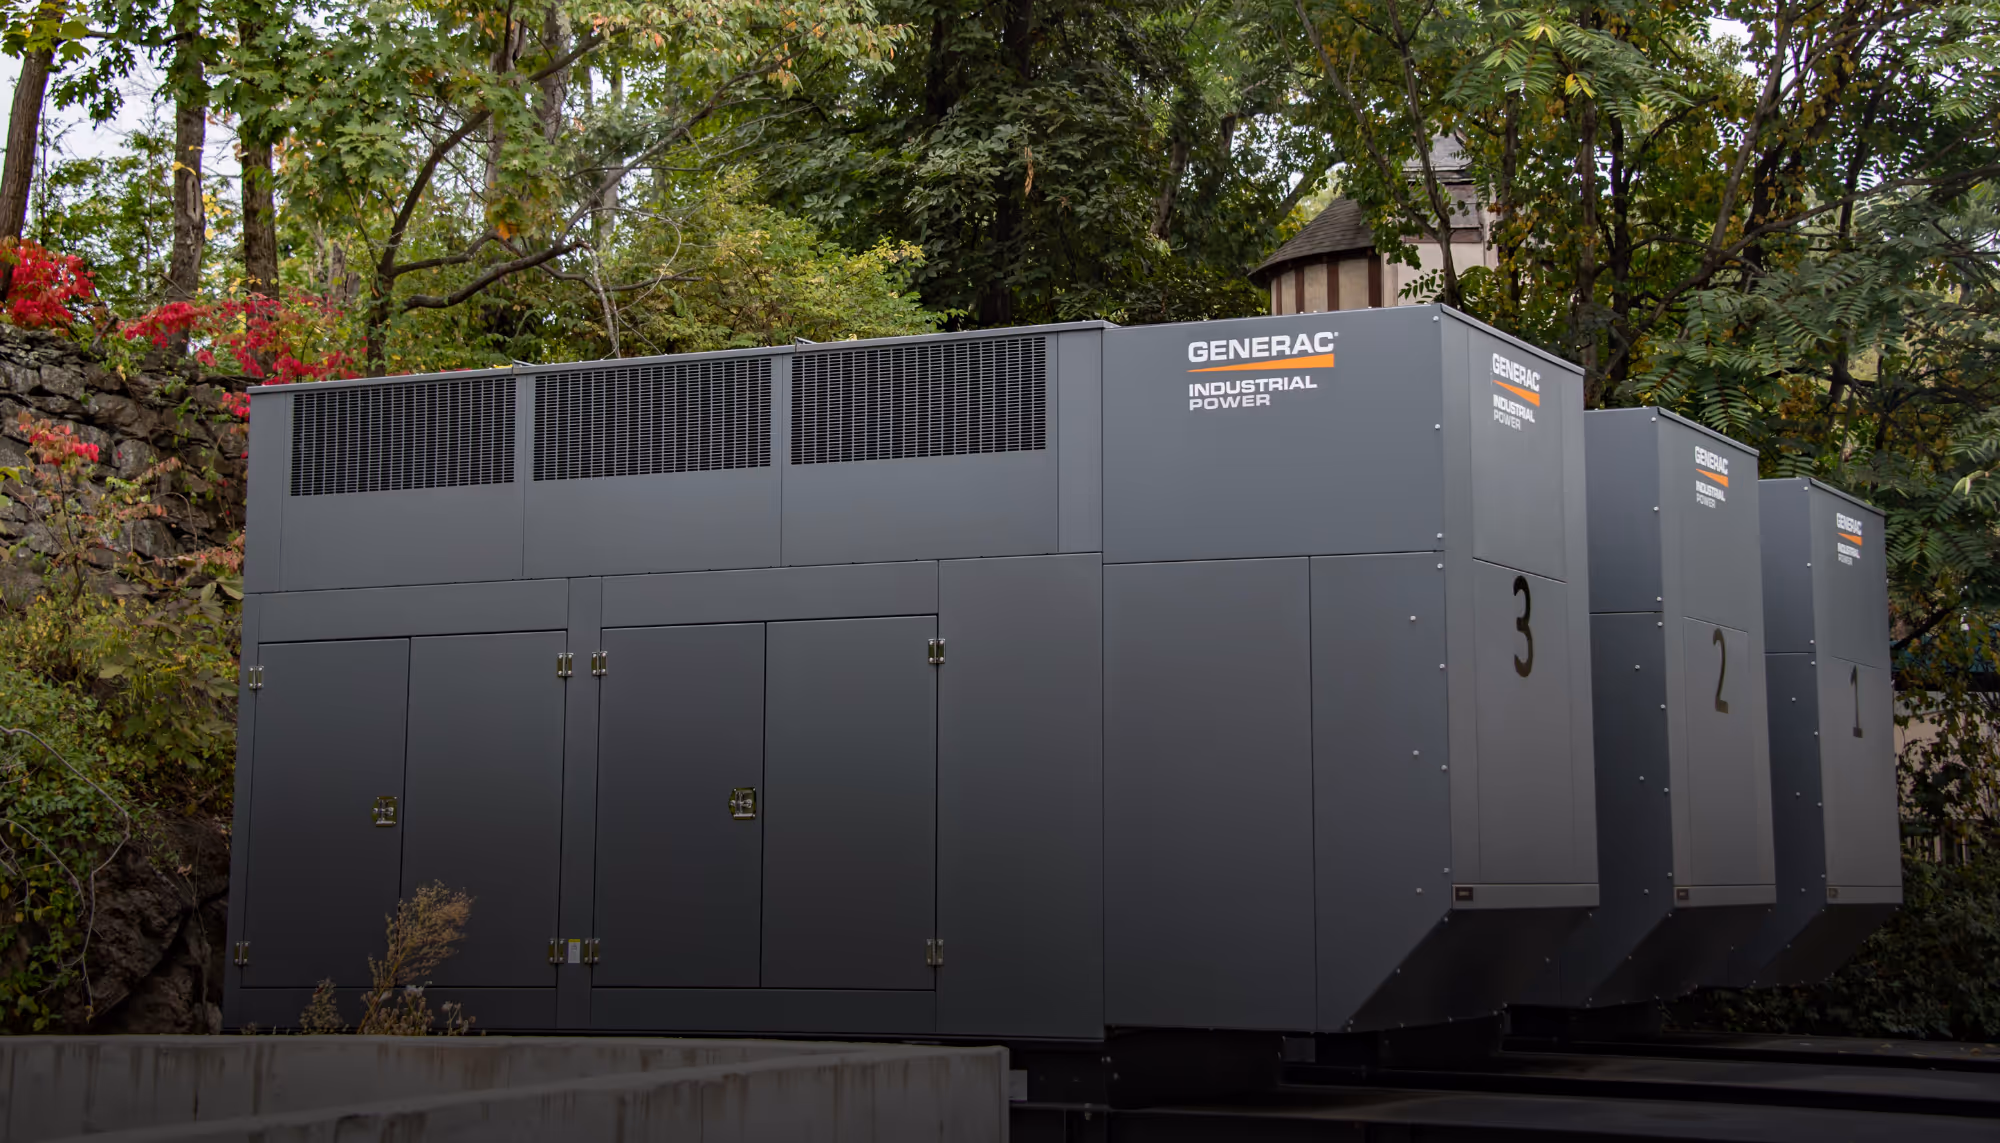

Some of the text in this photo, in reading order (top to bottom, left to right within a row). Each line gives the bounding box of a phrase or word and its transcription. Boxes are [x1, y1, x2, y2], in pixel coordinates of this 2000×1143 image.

[1188, 332, 1335, 363] GENERAC
[1189, 376, 1318, 397] INDUSTRIAL
[1492, 353, 1540, 392] GENERAC
[1189, 394, 1271, 411] POWER
[1493, 394, 1535, 423] INDUSTRIAL
[1493, 409, 1521, 430] POWER
[1695, 446, 1728, 475] GENERAC
[1513, 575, 1533, 678] 3
[1712, 628, 1729, 714] 2
[1849, 665, 1864, 738] 1
